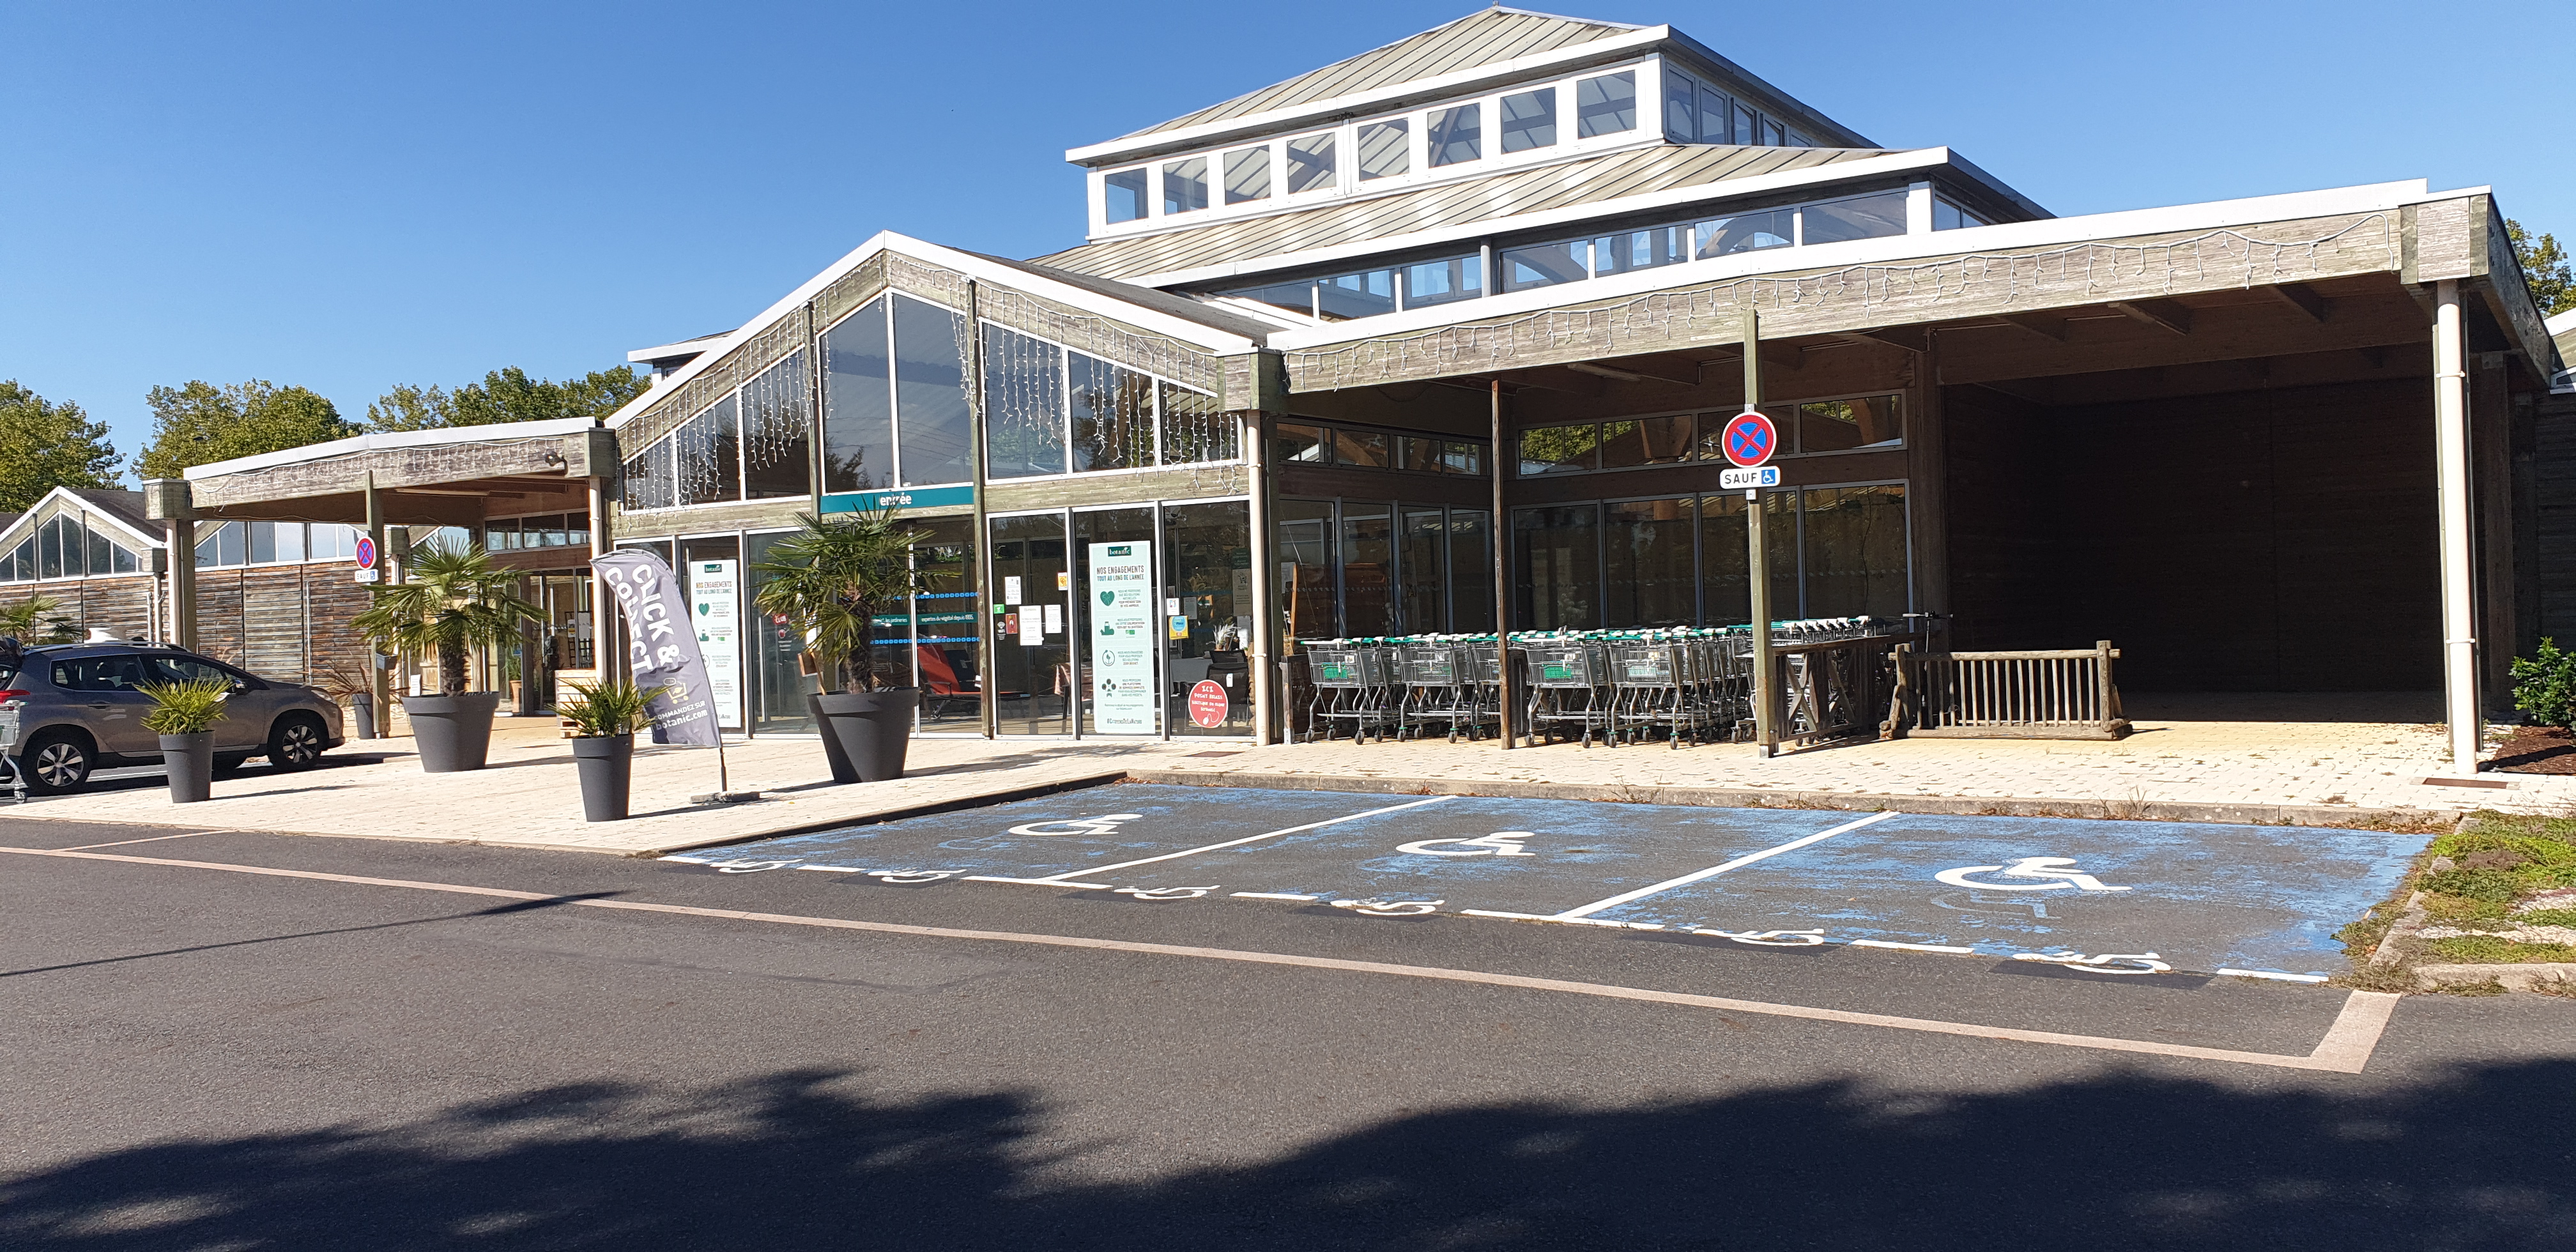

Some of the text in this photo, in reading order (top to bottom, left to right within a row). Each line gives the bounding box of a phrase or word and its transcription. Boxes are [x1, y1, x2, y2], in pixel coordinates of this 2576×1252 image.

[1724, 472, 1757, 484] SAUF
[1096, 565, 1144, 575] NOS ENGAGEMENTS
[632, 564, 680, 667] CLICK &
[694, 700, 706, 709] SUR
[656, 709, 708, 730] botanic.com
